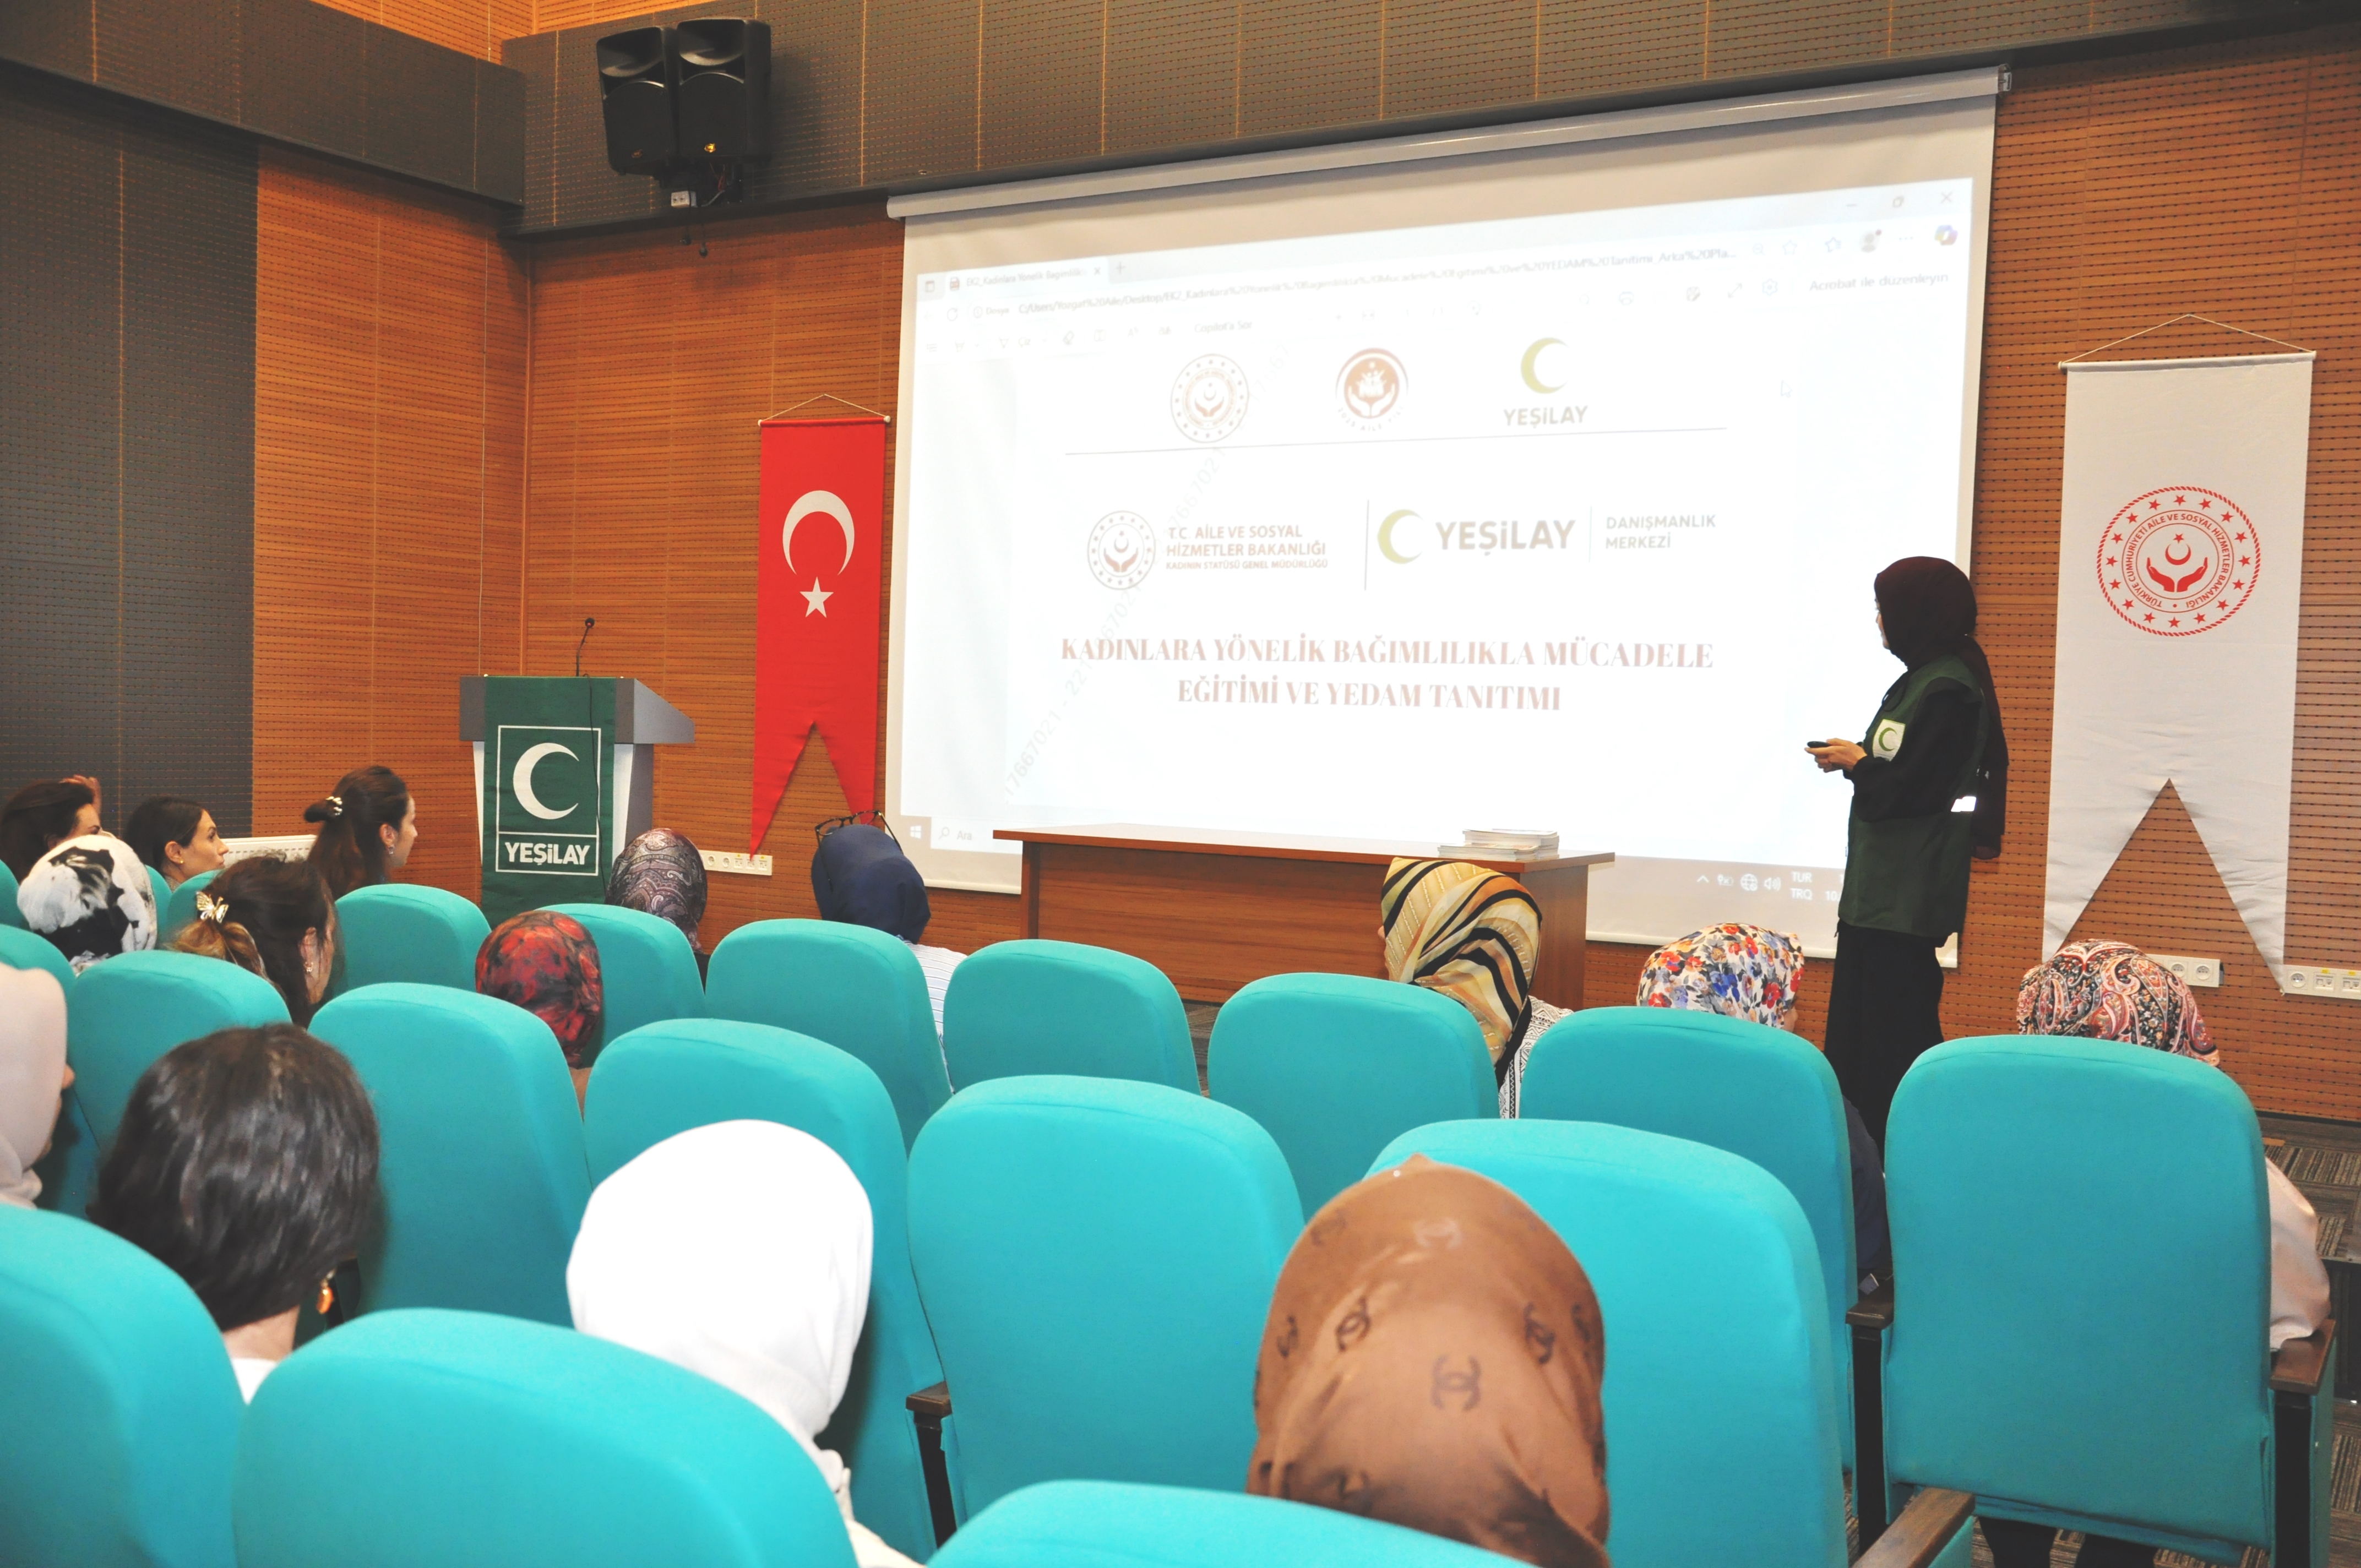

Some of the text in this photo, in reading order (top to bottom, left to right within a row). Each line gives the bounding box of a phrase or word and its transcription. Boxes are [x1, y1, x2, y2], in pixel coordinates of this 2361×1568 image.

[1809, 272, 1949, 292] Acrobat ile düzenleyin
[1237, 320, 1253, 331] Sor
[1018, 337, 1032, 349] Çiz
[1606, 514, 1716, 532] DANIŞMANLIK
[1195, 524, 1225, 539] AİLE
[1227, 526, 1245, 538] VE
[1249, 524, 1303, 538] SOSYAL
[1166, 539, 1326, 557] HİZMETLER BAKANLIĞI
[1605, 532, 1672, 549] MERKEZİ
[1166, 558, 1328, 570] KADININ STATÜSÜ GENEL MÜDÜRLÜĞÜ
[2125, 513, 2231, 608] TÜRKİYE CUMHURİYETİ AİLE VE SOSYAL HİZMETLER BAKANLIĞI
[1060, 632, 1714, 668] KADINLARA YÖNELİK BAĞIMLILIKLA MÜCADELE
[1178, 673, 1561, 711] EĞİTİMİ VE YEDAM TANITIMI
[956, 830, 972, 841] Ara
[1791, 871, 1813, 883] TUR
[1791, 888, 1813, 901] TRQ
